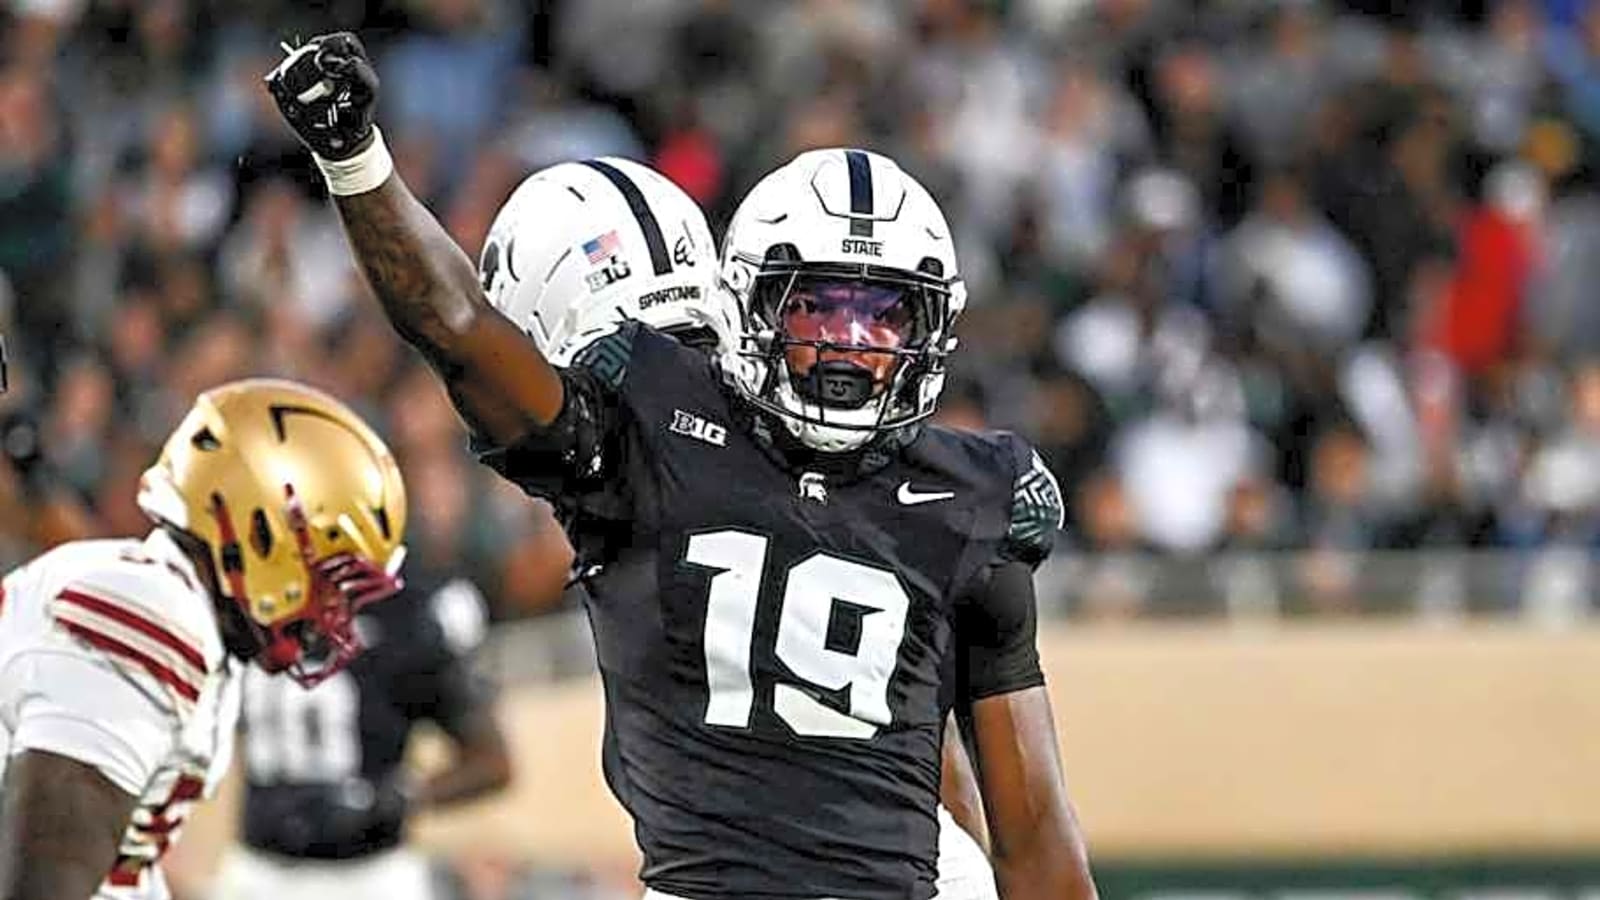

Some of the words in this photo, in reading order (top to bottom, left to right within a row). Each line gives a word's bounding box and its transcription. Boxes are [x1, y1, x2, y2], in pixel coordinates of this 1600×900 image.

[842, 239, 883, 258] STATE
[638, 285, 701, 310] SPARTANS
[685, 529, 911, 740] 19
